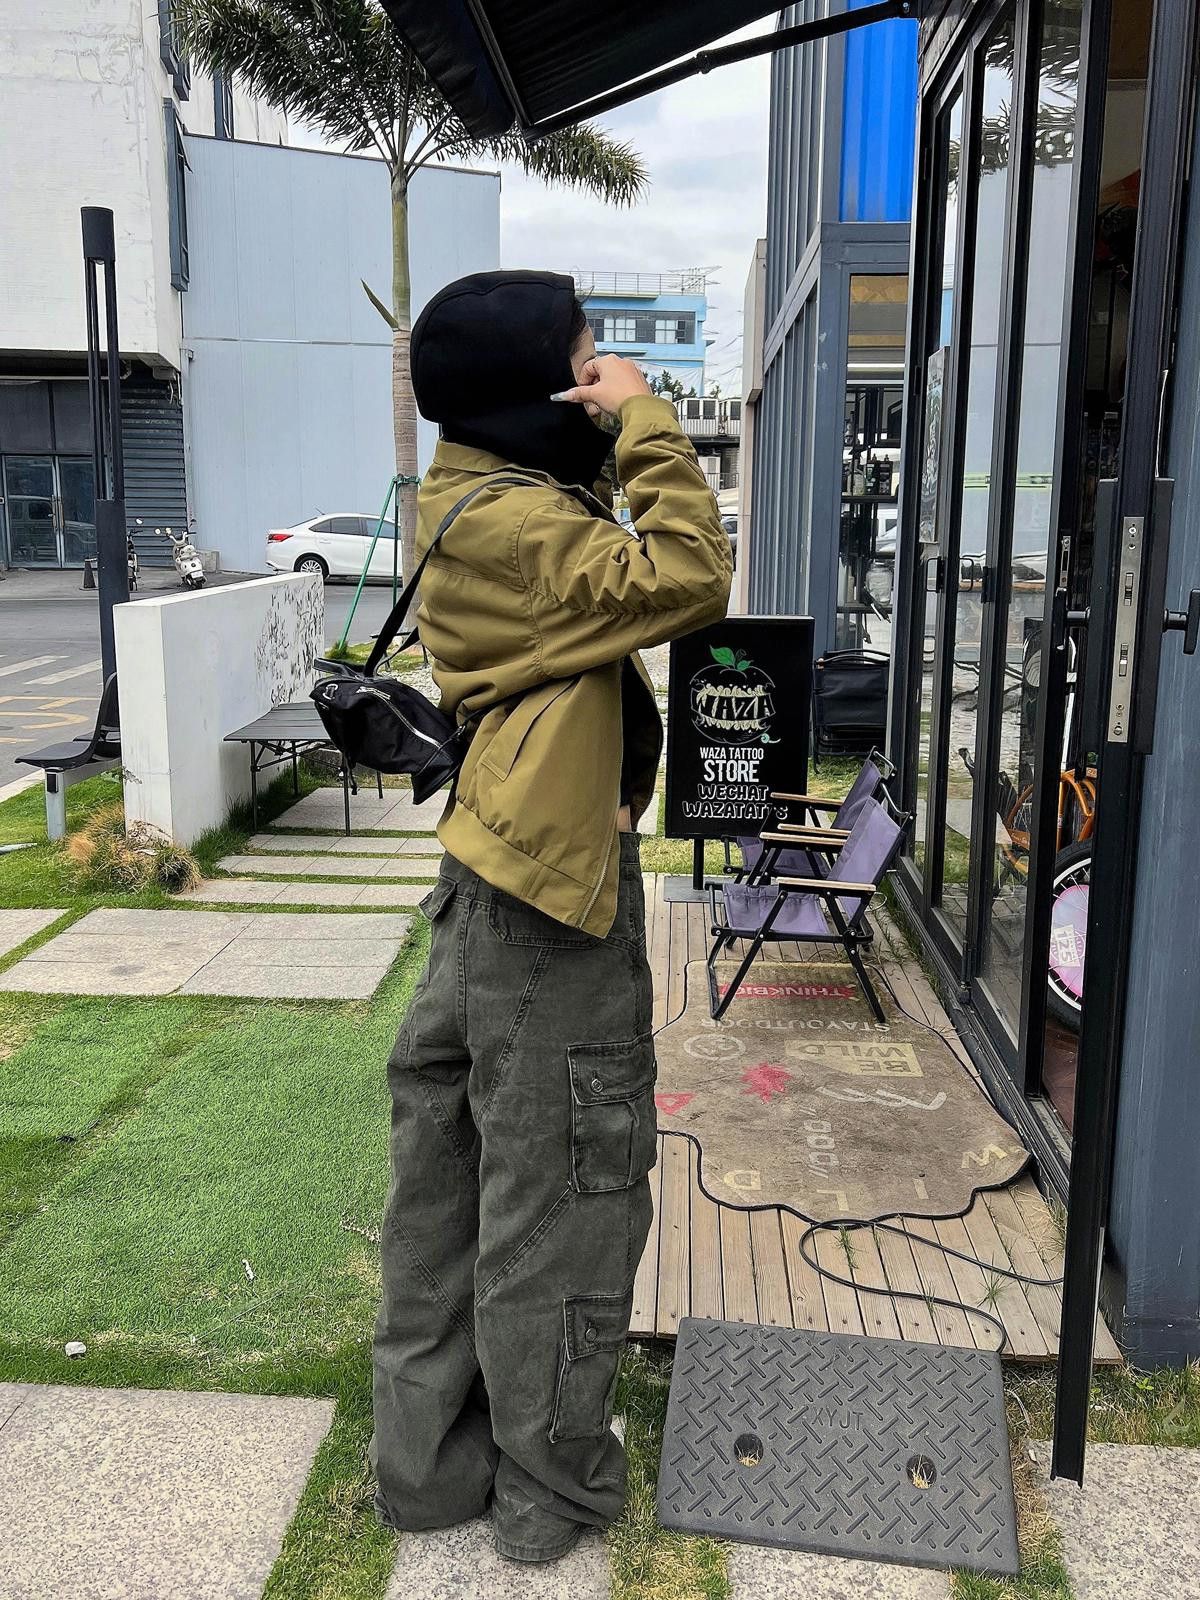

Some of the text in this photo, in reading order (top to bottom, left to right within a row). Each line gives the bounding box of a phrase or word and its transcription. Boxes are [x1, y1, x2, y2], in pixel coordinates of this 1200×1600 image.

[699, 746, 764, 760] WAZA TATTOO
[703, 759, 760, 783] STORE
[697, 783, 769, 801] WECHAT
[799, 1043, 907, 1058] WILD
[857, 1060, 912, 1073] BE
[811, 1405, 864, 1431] XYJT
